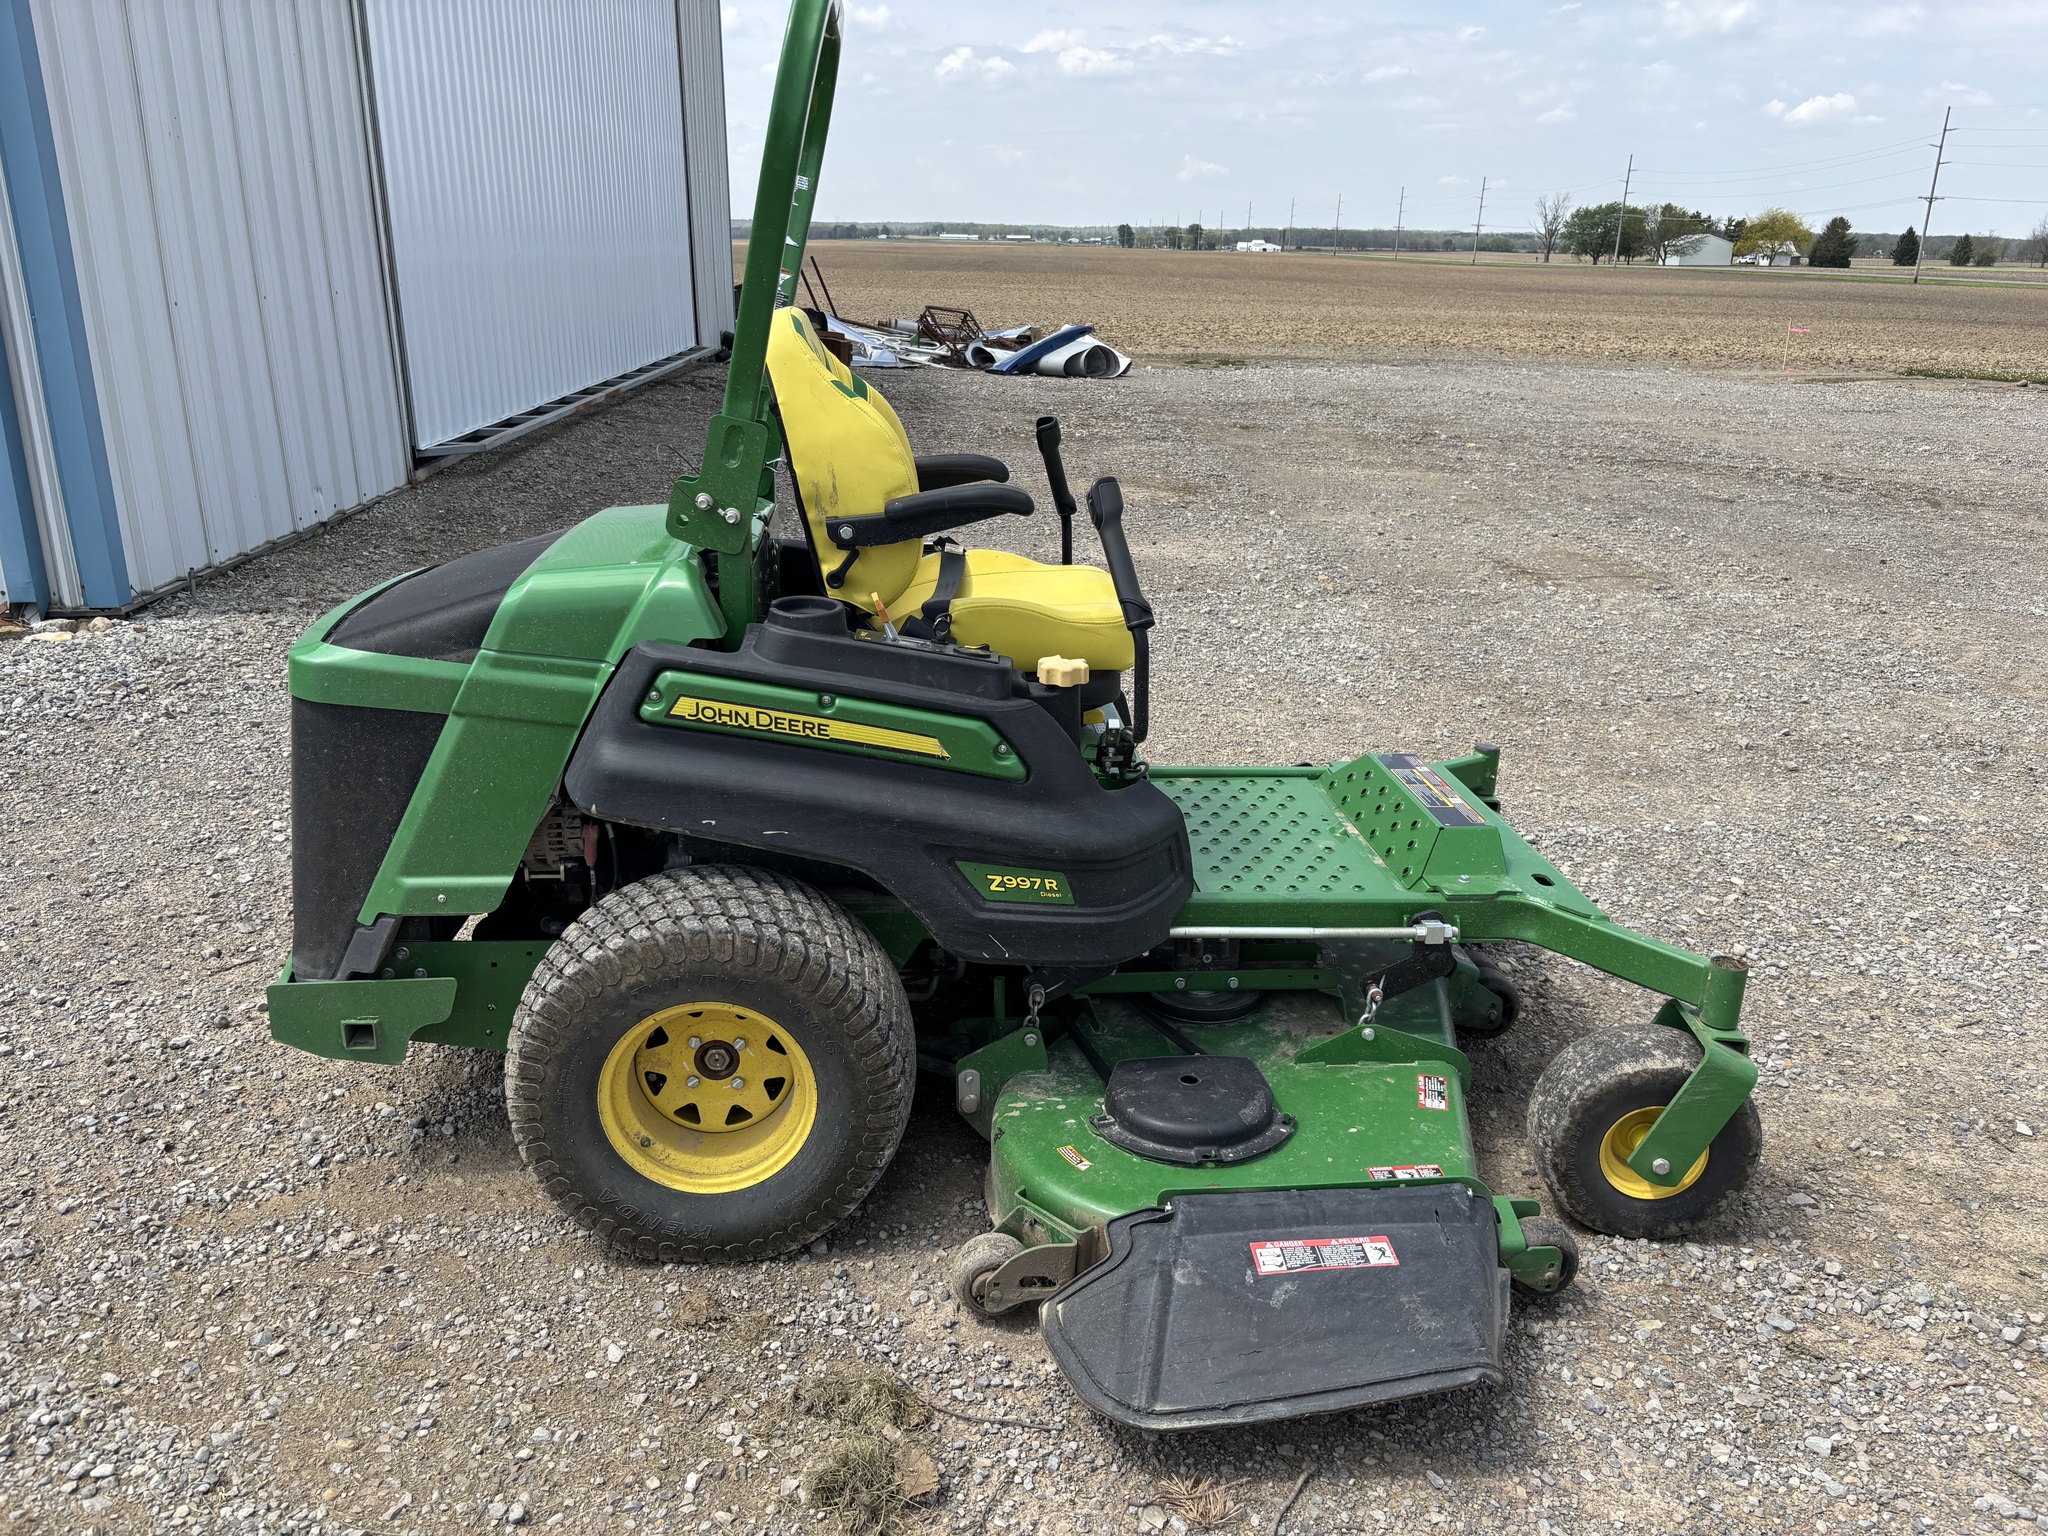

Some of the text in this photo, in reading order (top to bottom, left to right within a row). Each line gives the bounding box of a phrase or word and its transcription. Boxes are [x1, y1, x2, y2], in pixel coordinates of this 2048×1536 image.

[687, 701, 831, 738] JOHN DEERE
[1040, 890, 1062, 898] Diesel
[597, 1187, 713, 1239] KENDA
